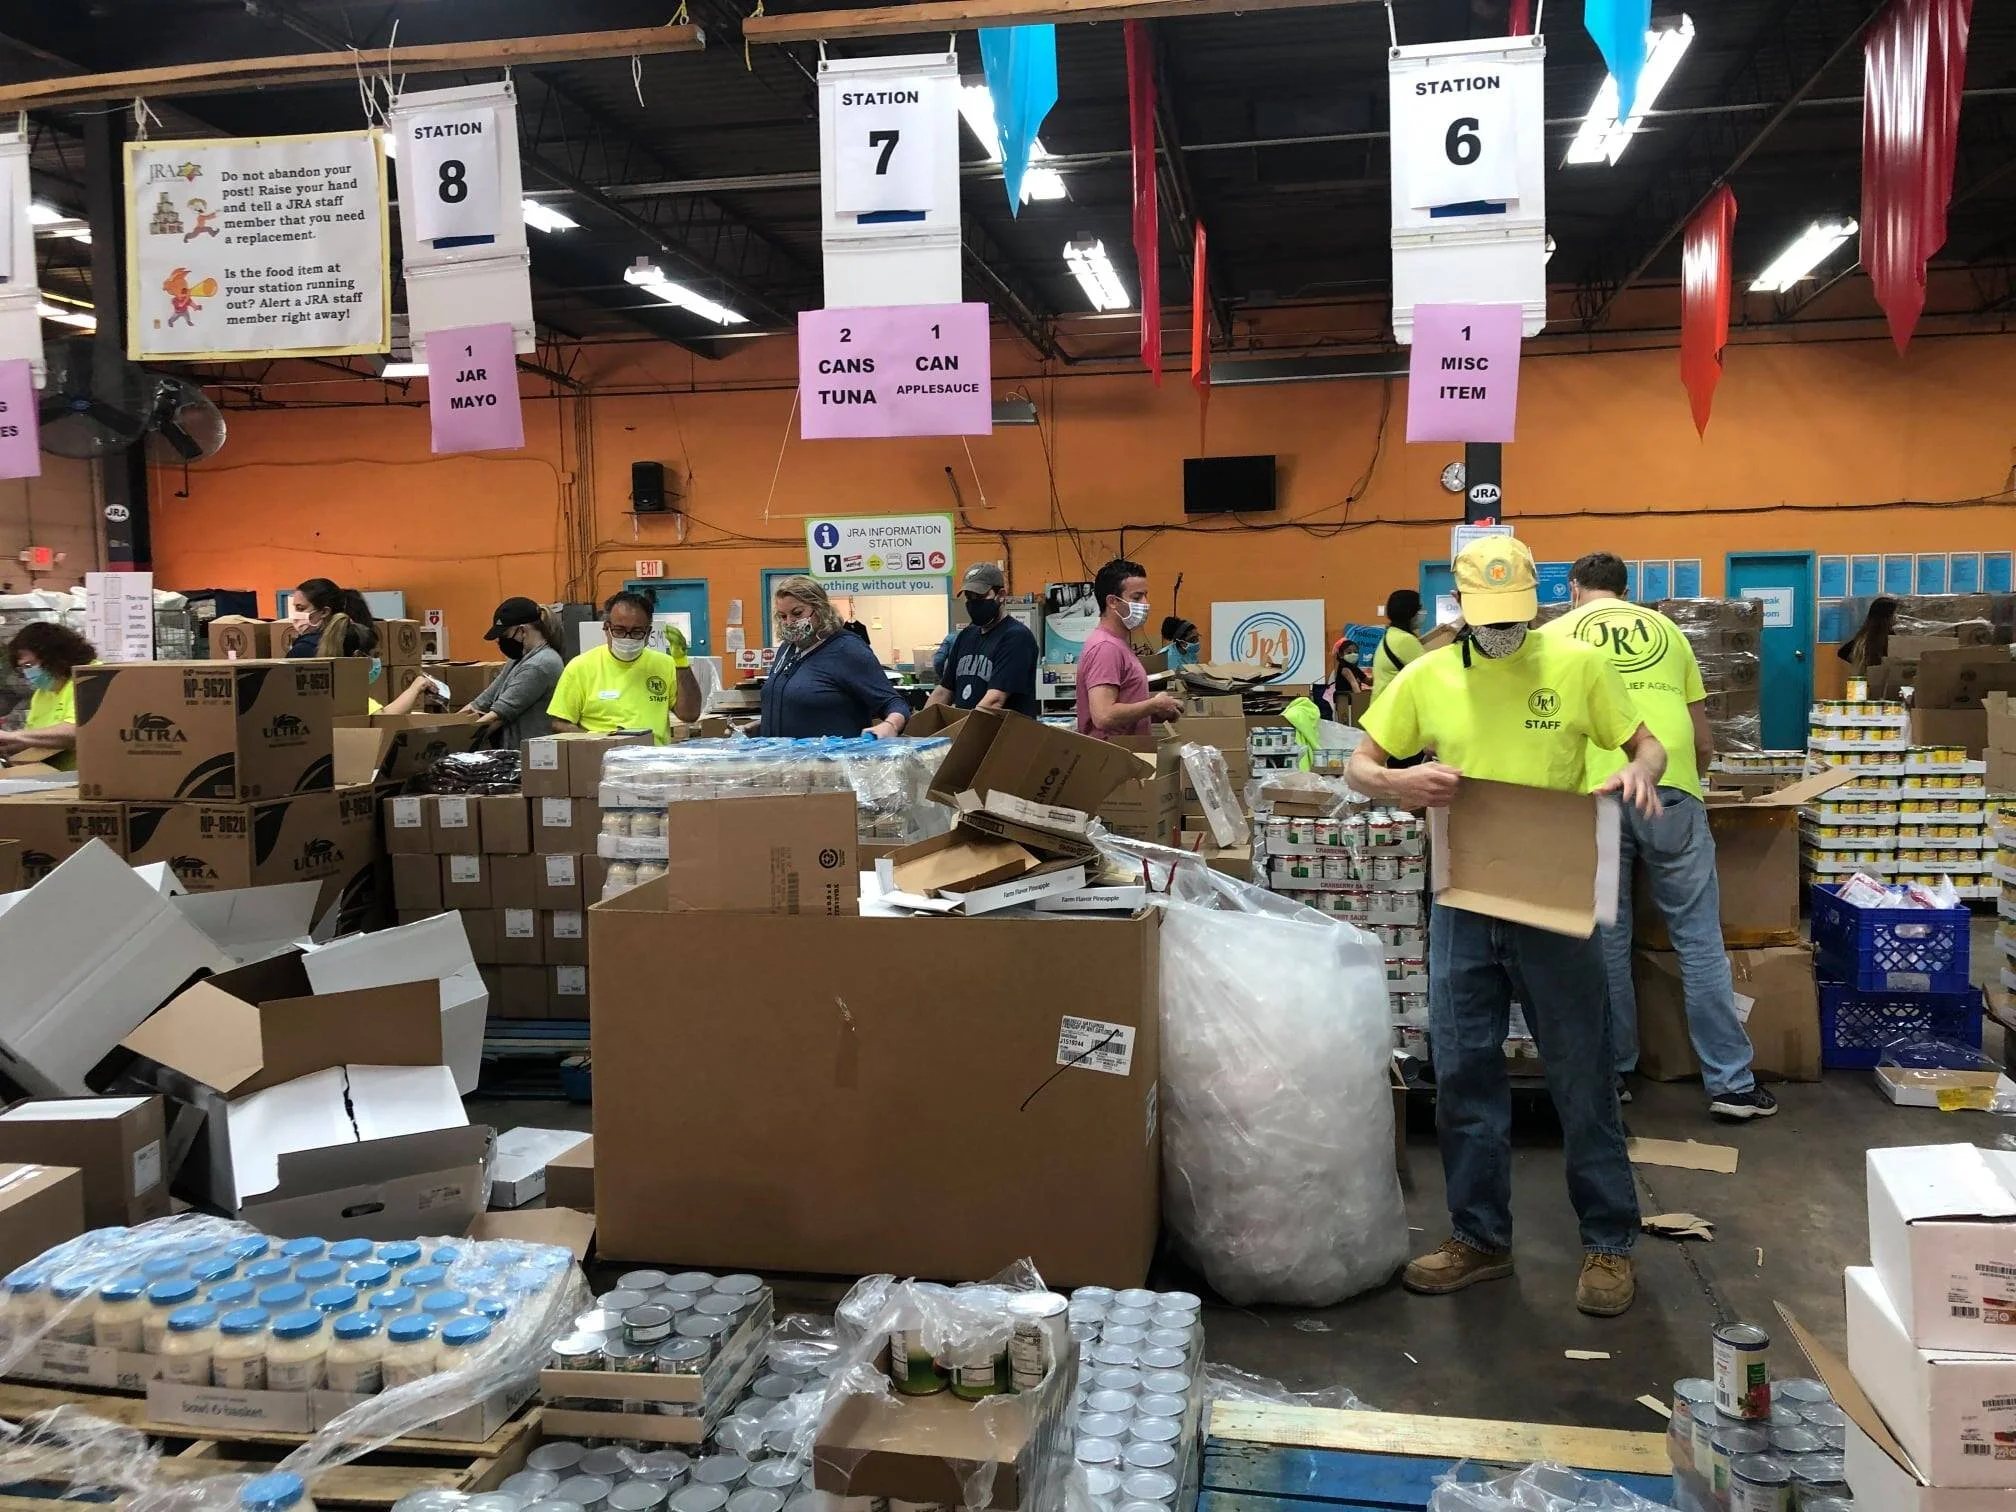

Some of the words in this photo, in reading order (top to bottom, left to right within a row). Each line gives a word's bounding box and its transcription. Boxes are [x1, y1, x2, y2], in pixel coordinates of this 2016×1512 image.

[1414, 75, 1501, 96] STATION
[841, 90, 919, 106] STATION
[413, 120, 482, 140] STATION
[1444, 117, 1482, 166] 6
[868, 129, 900, 176] 7
[146, 163, 176, 185] JRA
[221, 171, 238, 182] Do
[242, 171, 264, 182] not
[268, 167, 321, 180] abandon
[324, 165, 352, 180] your
[438, 159, 468, 205] 8
[221, 186, 254, 200] post!
[258, 184, 292, 197] Raise
[296, 183, 324, 197] your
[327, 178, 358, 191] hand
[223, 202, 247, 214] and
[250, 201, 272, 212] tell
[275, 203, 282, 211] a
[286, 197, 312, 211] JRA
[314, 195, 344, 208] staff
[224, 216, 276, 230] member
[279, 213, 306, 226] that
[309, 214, 331, 230] you
[335, 209, 366, 223] need
[224, 235, 232, 245] a
[236, 230, 317, 246] replacement.
[224, 268, 237, 279] Is
[240, 266, 262, 279] the
[265, 265, 294, 277] food
[297, 263, 324, 276] item
[327, 262, 342, 273] at
[225, 283, 255, 297] your
[258, 280, 302, 294] station
[306, 278, 356, 292] running
[226, 297, 255, 310] out?
[259, 296, 290, 309] Alert
[294, 298, 302, 307] a
[304, 294, 329, 307] JRA
[333, 292, 363, 304] staff
[226, 312, 278, 325] member
[281, 310, 312, 324] right
[314, 308, 351, 322] away!
[839, 327, 852, 343] 2
[931, 324, 941, 340] 1
[1462, 325, 1472, 341] 1
[463, 344, 472, 359] 1
[818, 357, 876, 375] CANS
[915, 354, 960, 372] CAN
[1441, 356, 1489, 371] MISC
[455, 367, 488, 384] JAR
[818, 388, 877, 406] TUNA
[896, 382, 980, 395] APPLESAUCE
[1440, 385, 1487, 401] ITEM
[449, 393, 498, 411] MAYO
[1472, 487, 1499, 500] JRA
[107, 507, 128, 518] JRA
[846, 528, 867, 538] JRA
[868, 525, 942, 538] INFORMATION
[868, 537, 913, 549] STATION
[640, 561, 659, 576] EXIT
[861, 579, 907, 591] without
[908, 582, 934, 593] you.
[1764, 596, 1781, 605] eak
[1591, 617, 1652, 656] JRA
[1246, 628, 1290, 668] JRA
[1533, 696, 1555, 711] JRA
[262, 725, 311, 739] ULTRA
[1525, 719, 1562, 731] STAFF
[120, 728, 188, 743] ULTRA
[293, 850, 345, 872] ULTRA
[183, 868, 219, 880] TRA
[1003, 889, 1015, 899] Farm
[1014, 887, 1029, 897] Flavor
[1028, 881, 1051, 894] Pineapple
[1092, 894, 1120, 903] Pineapple
